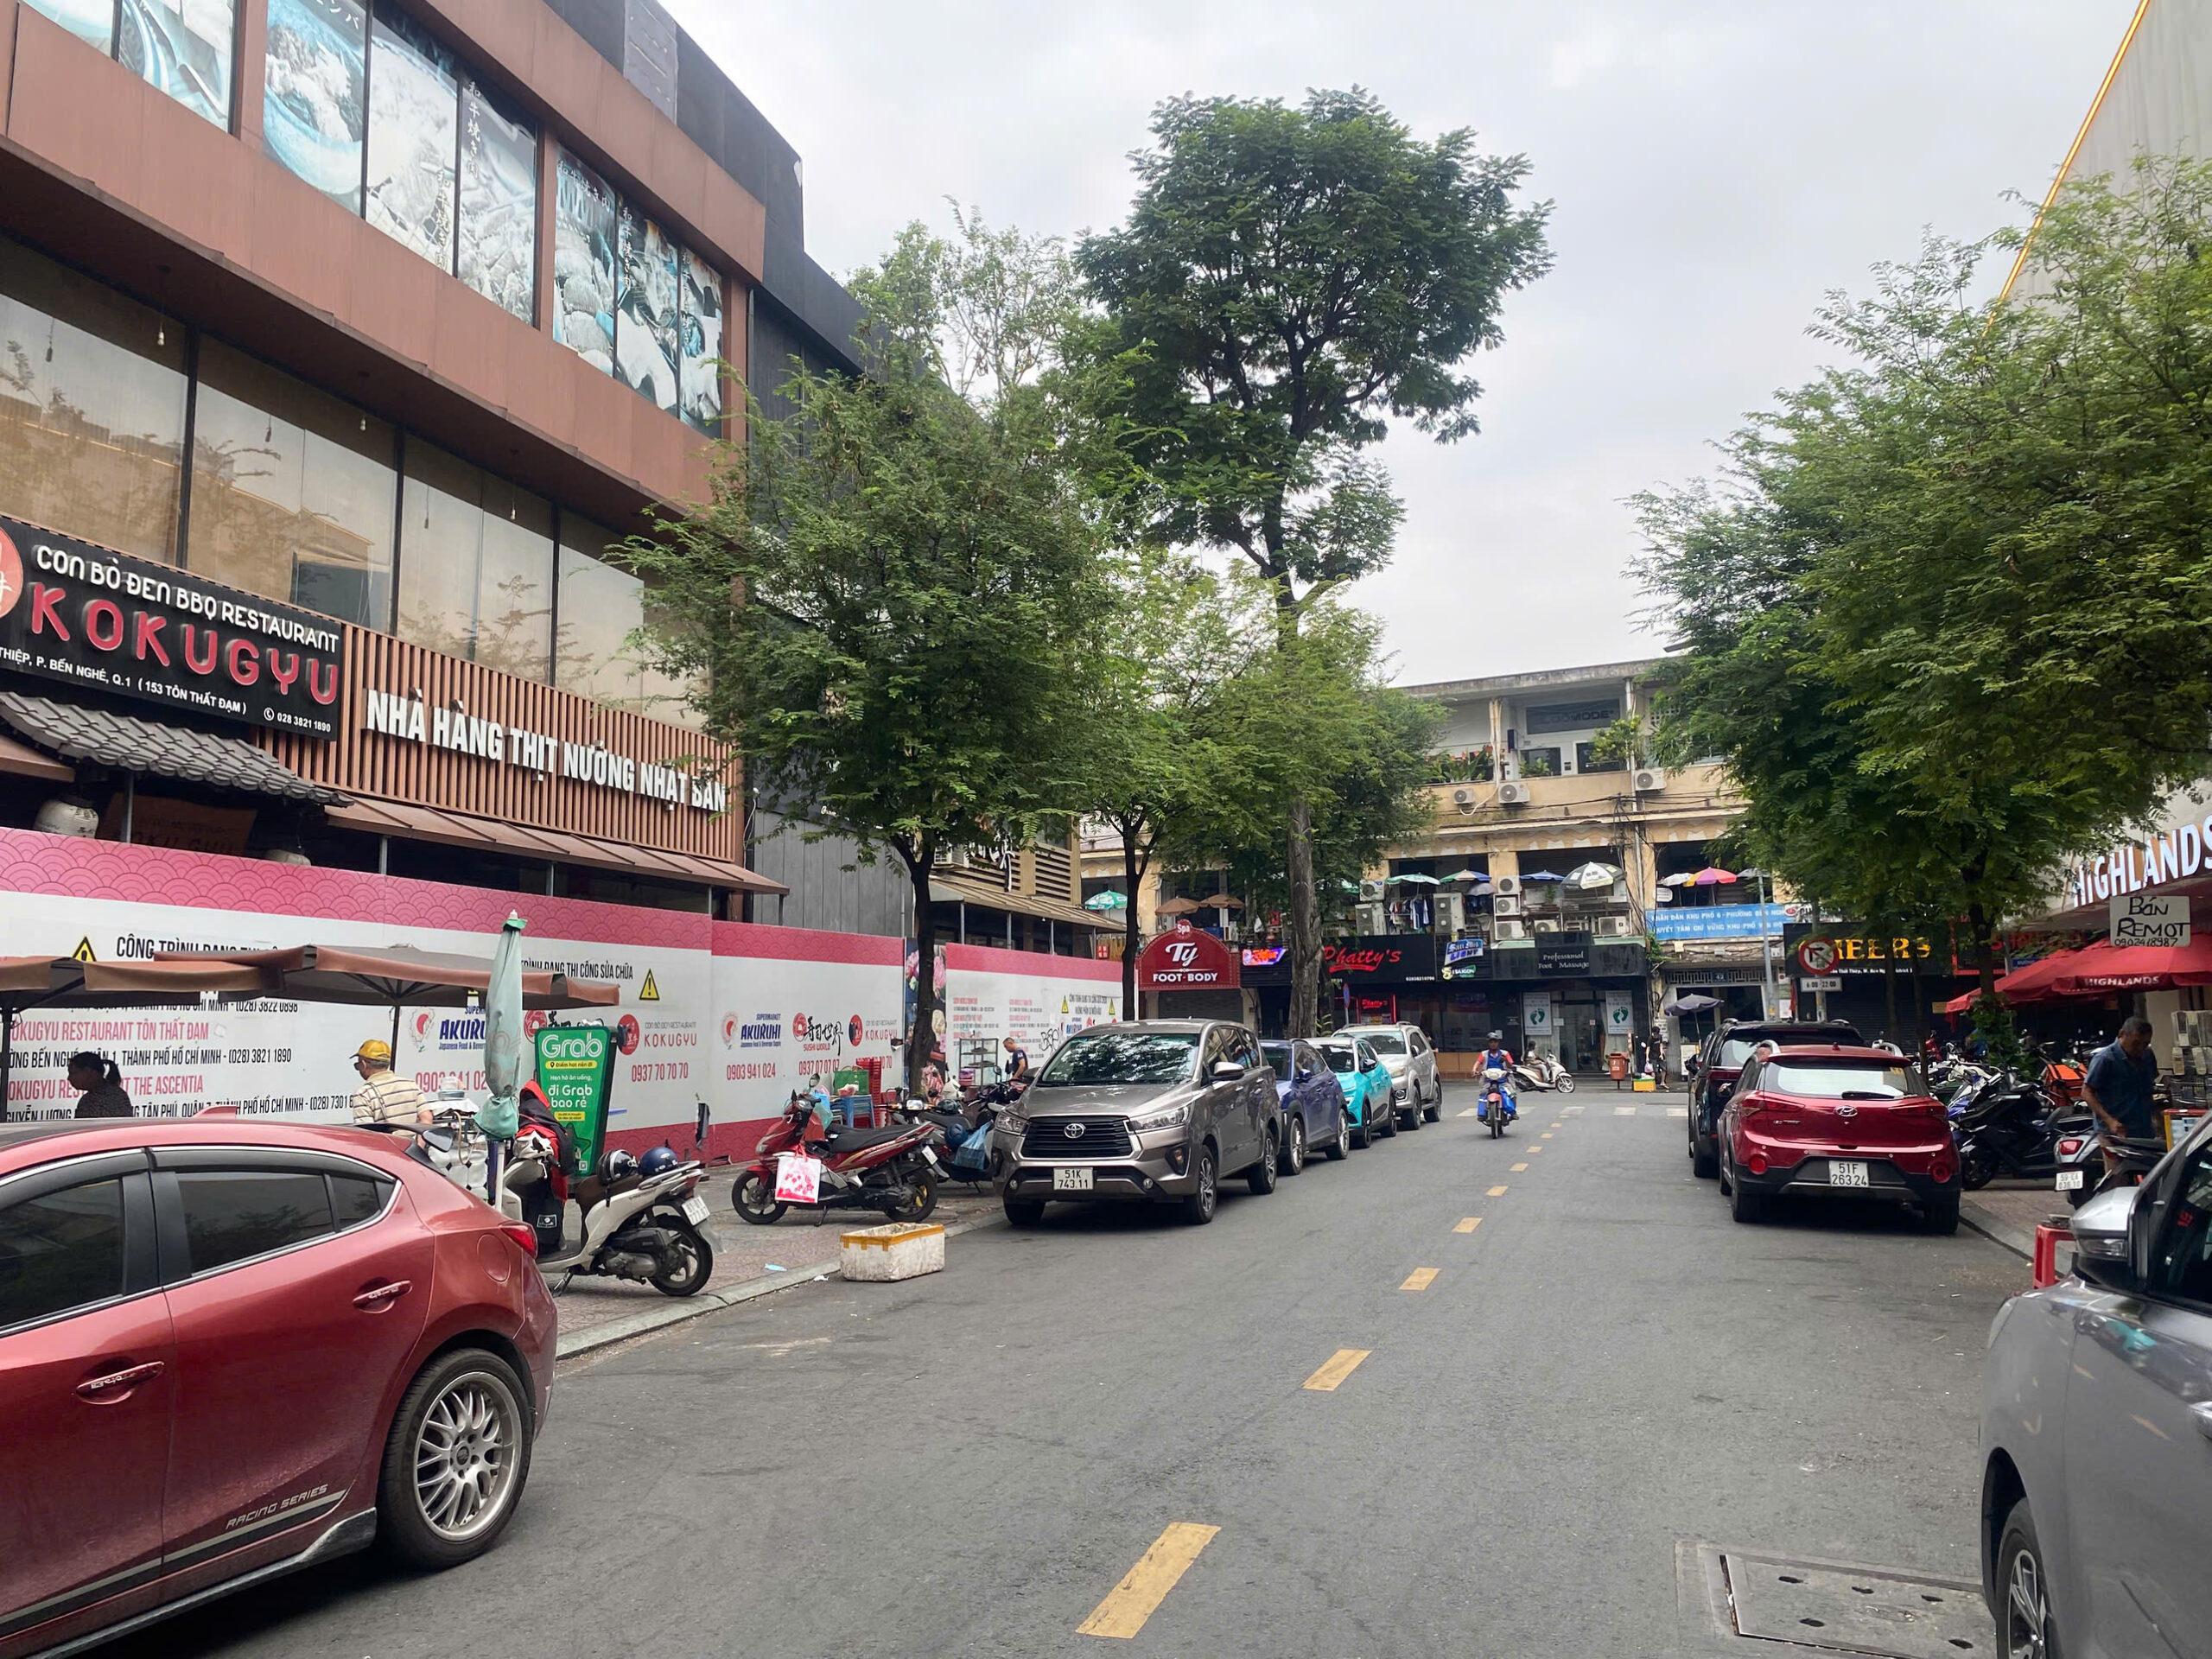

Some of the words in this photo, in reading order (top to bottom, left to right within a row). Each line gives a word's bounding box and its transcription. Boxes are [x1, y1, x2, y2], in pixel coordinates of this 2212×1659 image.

[35, 545, 85, 580] CON
[91, 556, 121, 589] BÒ
[126, 572, 170, 605] ĐEN
[176, 586, 218, 620] BBQ
[221, 601, 339, 653] RESTAURANT
[32, 582, 338, 705] KOKUGYU
[36, 656, 47, 669] P.
[50, 658, 73, 674] BẾN
[76, 665, 109, 683] NGHÉ,
[112, 674, 130, 688] Q.1
[166, 683, 188, 701] TÔN
[190, 689, 216, 709] THẤT
[219, 698, 240, 715] ĐẠM
[276, 713, 291, 725] 028
[294, 715, 312, 729] 3821
[314, 719, 331, 733] 1890
[366, 688, 426, 742] NHÀ
[432, 699, 503, 761] HÀNG
[510, 728, 558, 781] THỊT
[563, 740, 635, 791] NƯỚNG
[1176, 923, 1191, 936] Spa
[2117, 918, 2190, 938] REMOT
[117, 933, 154, 958] CÔNG
[1165, 942, 1199, 967] Ty
[1543, 950, 1584, 962] Professional
[567, 963, 578, 978] THI
[580, 961, 599, 979] CÔNG
[600, 959, 614, 980] SỬA
[615, 963, 633, 981] CHỮA
[1153, 972, 1182, 982] FOOT
[1187, 972, 1218, 982] BODY
[2084, 976, 2159, 987] HIGHLANDS
[11, 1020, 58, 1041] OKUGYU
[62, 1020, 136, 1041] RESTAURANT
[137, 1018, 156, 1041] TÔN
[160, 1017, 184, 1040] THẤT
[188, 1021, 209, 1044] ĐẠM
[439, 1019, 486, 1039] AKURU
[741, 1023, 781, 1039] AKURUHI
[541, 1032, 602, 1058] Grab
[644, 1033, 696, 1047] KOKUGYU
[9, 1048, 29, 1068] ỜNG
[32, 1046, 52, 1068] BẾN
[54, 1047, 79, 1067] NGH
[123, 1046, 150, 1066] THÀNH
[153, 1046, 171, 1065] PHỐ
[172, 1046, 183, 1065] HỒ
[185, 1046, 199, 1065] CHÍ
[200, 1048, 221, 1064] MINH
[229, 1048, 250, 1064] (028)
[251, 1048, 270, 1064] 3821
[274, 1048, 292, 1063] 1890
[798, 1060, 814, 1075] 0937
[815, 1060, 823, 1074] 07
[823, 1059, 831, 1073] 07
[474, 1071, 486, 1090] 02
[632, 1065, 652, 1083] 0937
[654, 1064, 665, 1081] 70
[667, 1064, 677, 1079] 70
[678, 1063, 688, 1078] 70
[727, 1065, 746, 1080] 0903
[747, 1063, 760, 1079] 941
[762, 1063, 776, 1078] 024
[8, 1080, 56, 1102] OKUGYU
[134, 1077, 152, 1096] THE
[156, 1075, 204, 1095] ASCENTIA
[548, 1084, 559, 1096] đi
[562, 1084, 593, 1096] Grab
[7, 1104, 38, 1122] GUYỄN
[243, 1096, 258, 1115] PHỐ
[260, 1095, 270, 1114] HỒ
[271, 1096, 284, 1113] CHÍ
[285, 1097, 303, 1112] MINH
[310, 1096, 329, 1110] (028)
[331, 1095, 347, 1109] 7301
[551, 1096, 573, 1108] bao
[575, 1096, 587, 1108] rẻ
[1065, 1169, 1081, 1179] 51K
[1838, 1163, 1859, 1174] 51F
[1058, 1179, 1089, 1189] 743.11
[225, 1502, 279, 1529] RACING
[280, 1484, 329, 1510] SERIES
